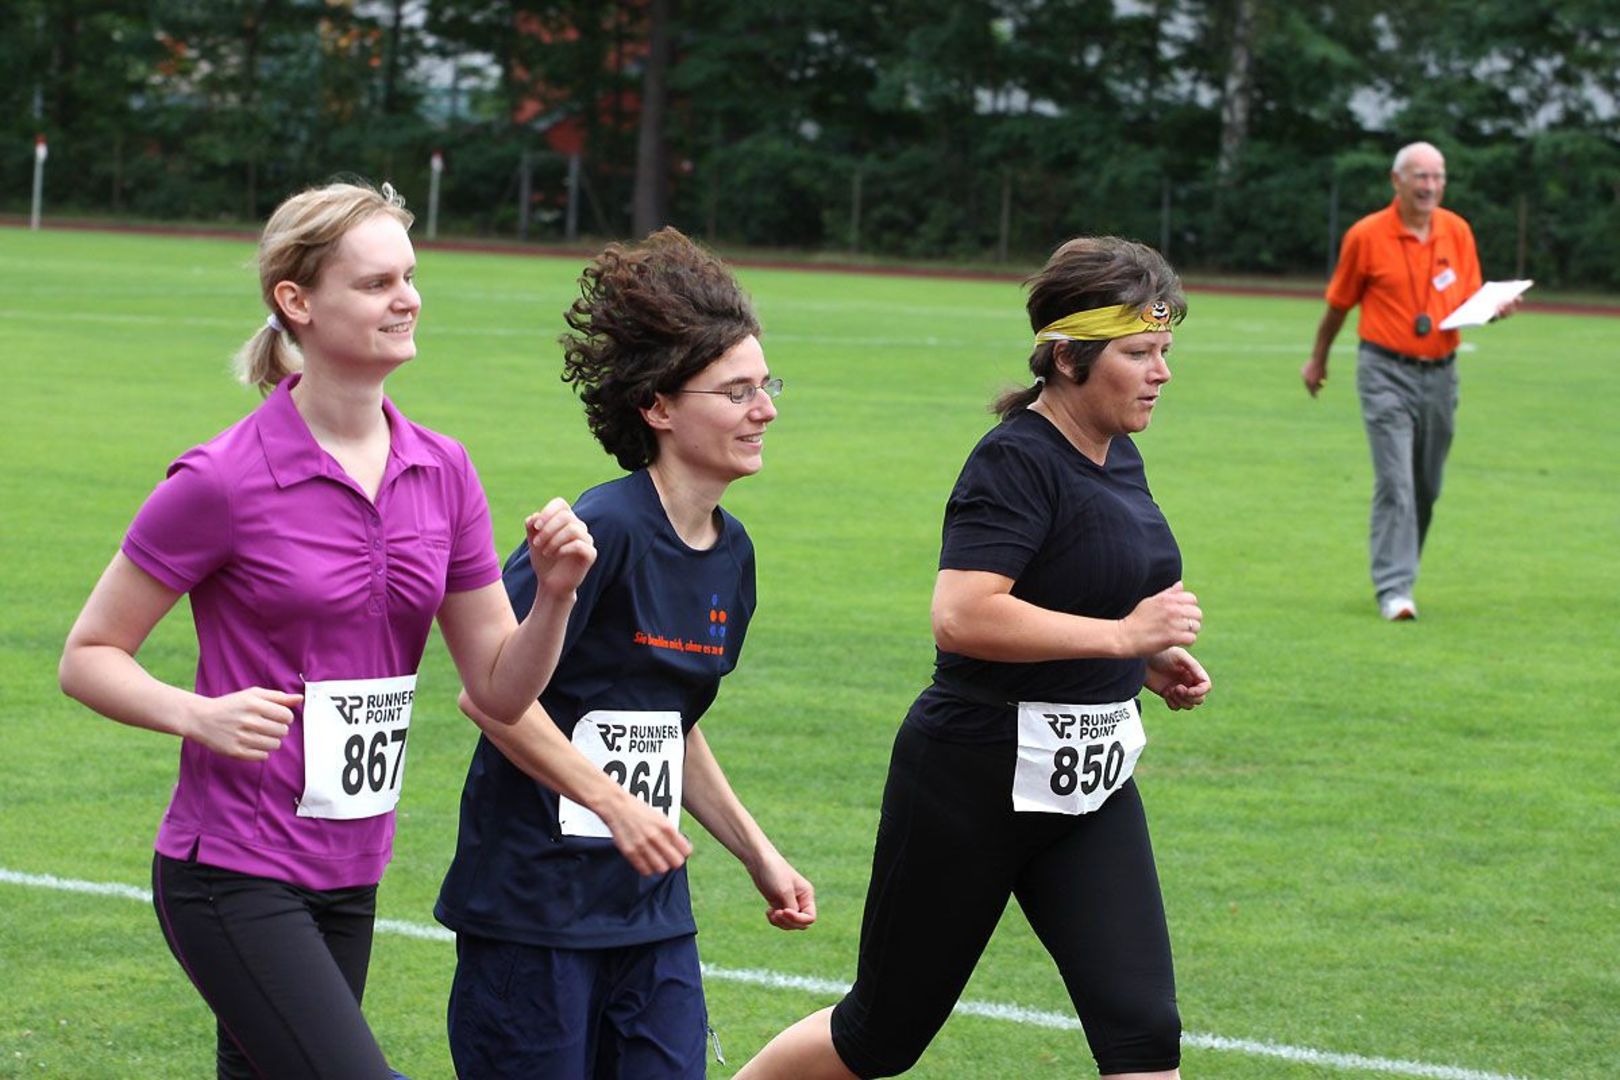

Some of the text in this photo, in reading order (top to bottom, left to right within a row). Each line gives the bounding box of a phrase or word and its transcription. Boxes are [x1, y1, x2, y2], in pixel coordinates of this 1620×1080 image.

[365, 707, 403, 725] POINT
[1079, 707, 1131, 727] RUNNERS
[629, 725, 679, 739] RUNNERS
[1079, 724, 1117, 740] POINT
[628, 739, 664, 753] POINT
[341, 728, 409, 796] 867
[1050, 740, 1125, 796] 850
